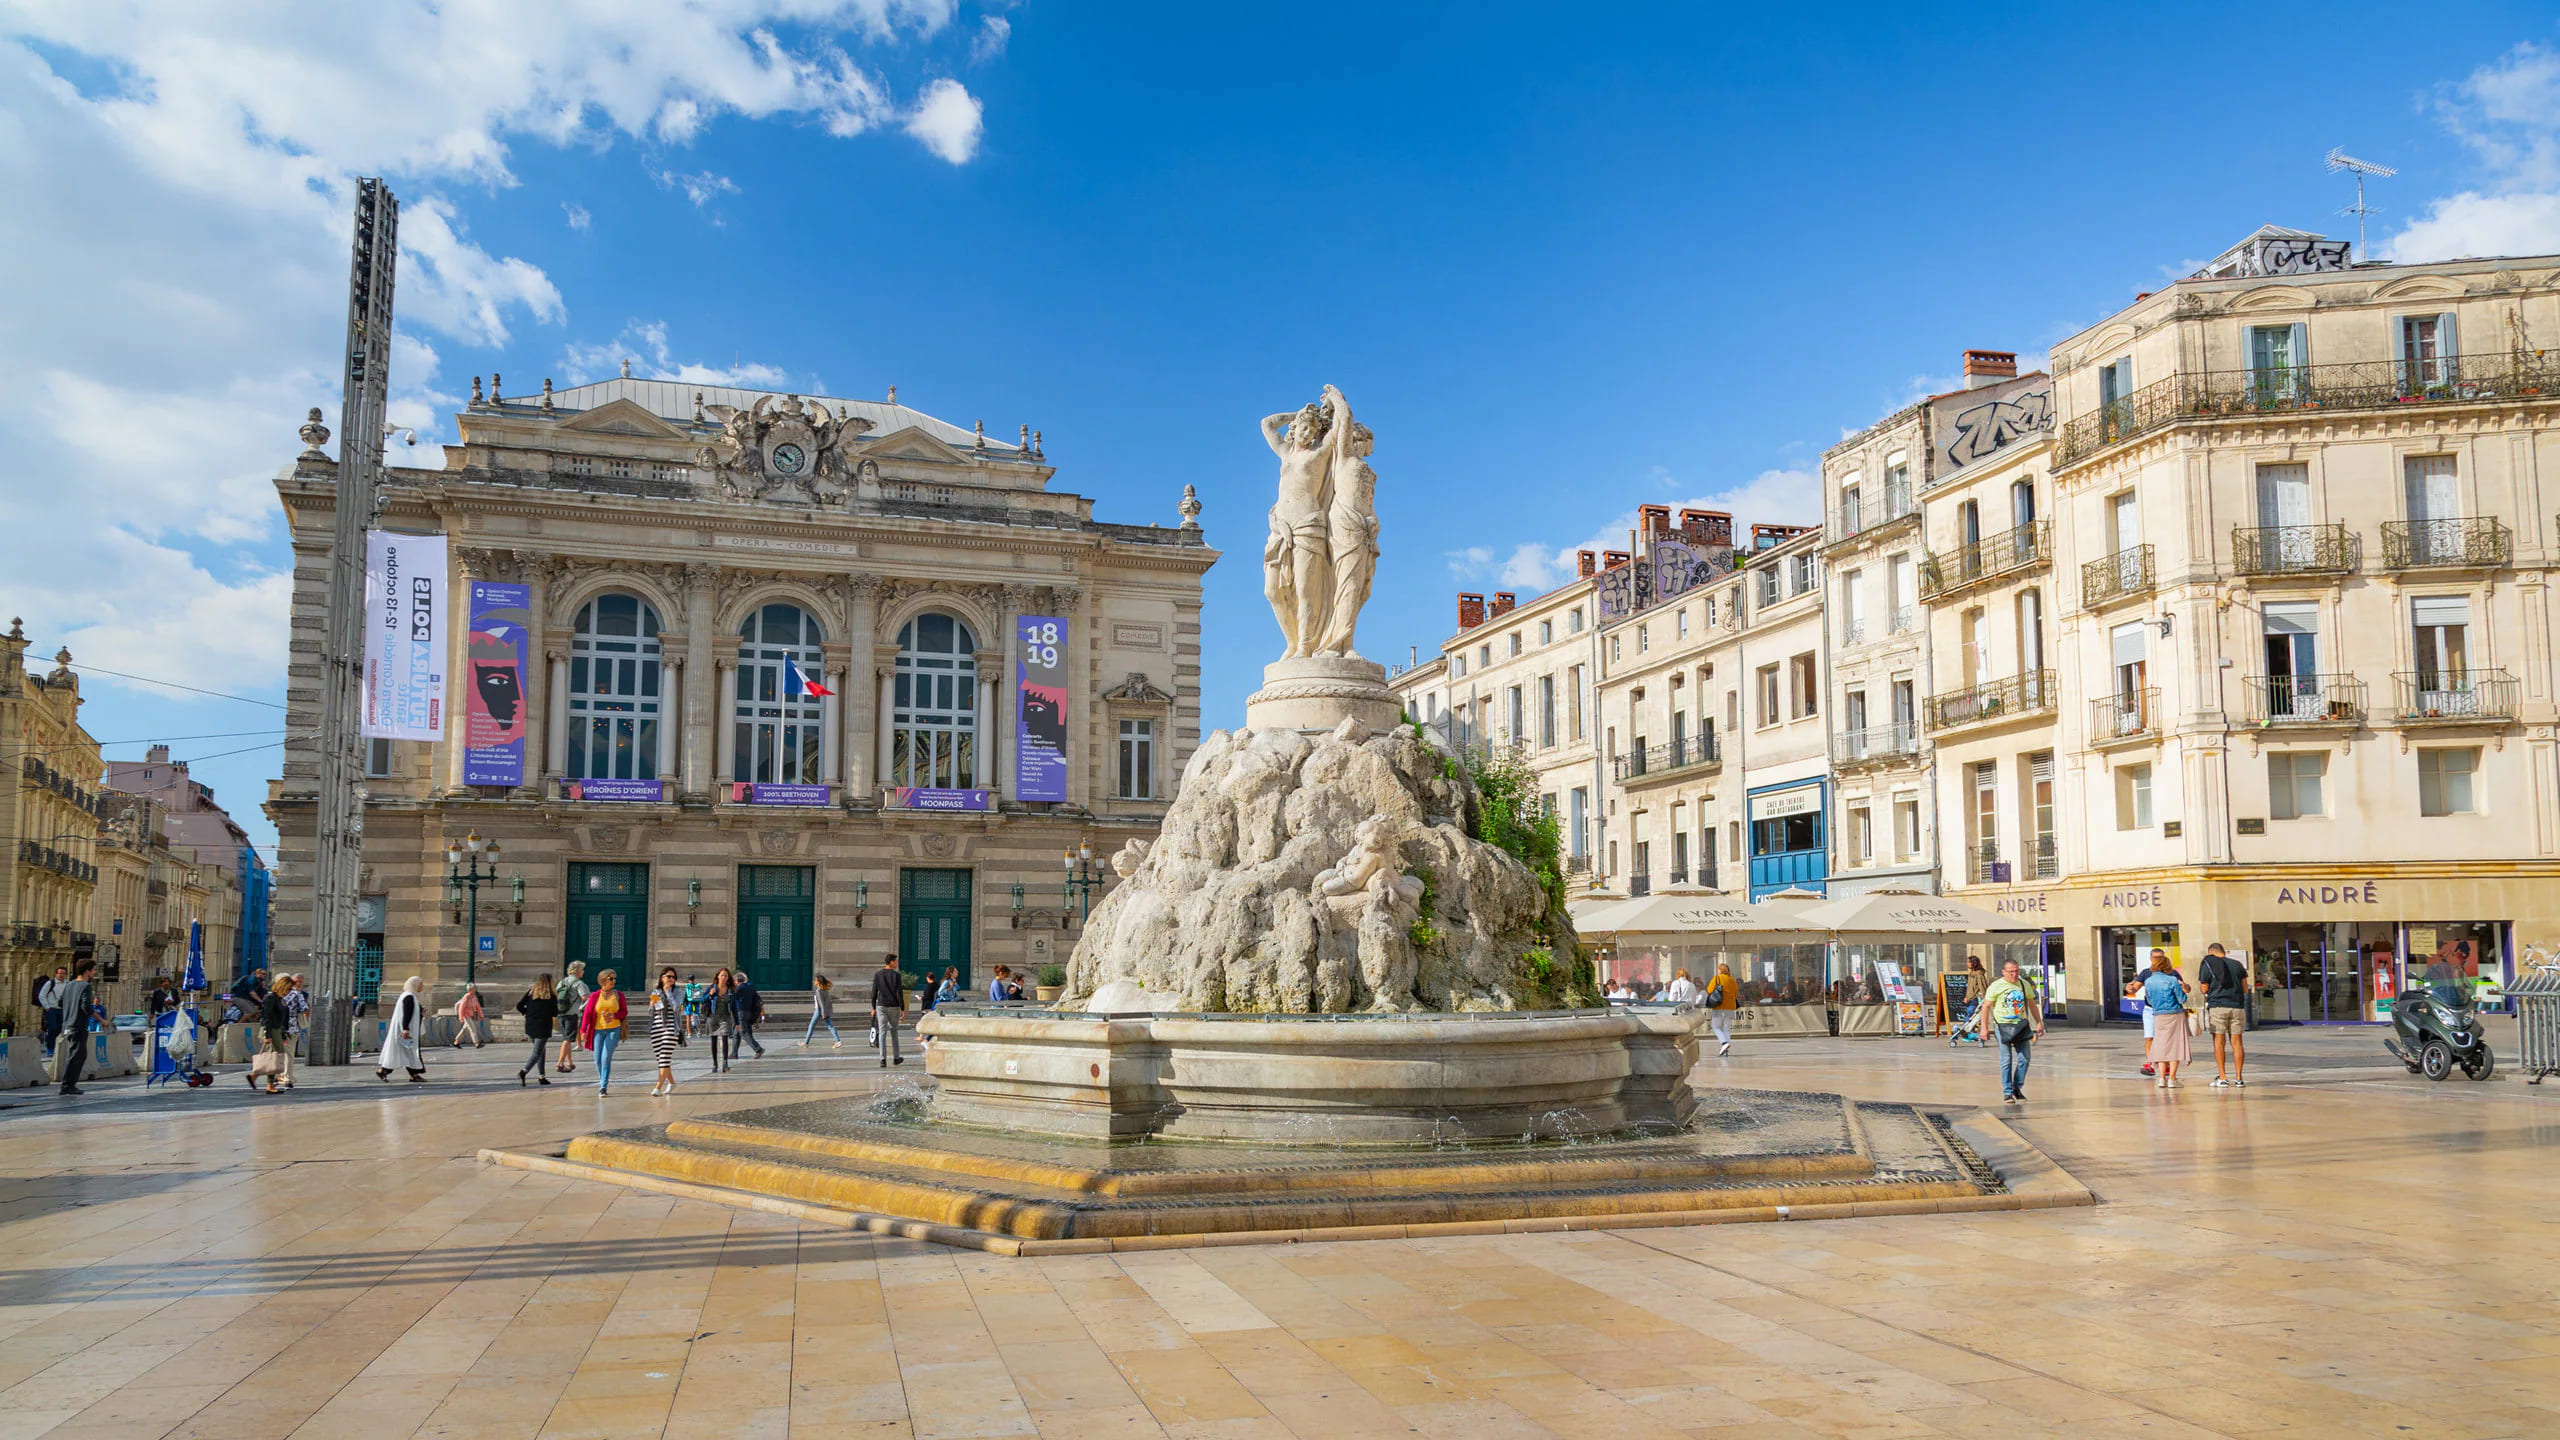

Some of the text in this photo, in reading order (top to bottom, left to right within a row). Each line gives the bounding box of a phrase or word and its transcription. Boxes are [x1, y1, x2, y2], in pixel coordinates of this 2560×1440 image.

[1028, 622, 1058, 645] 18
[1027, 645, 1058, 669] 19
[623, 786, 659, 795] D'ORIENT
[920, 800, 964, 808] MOONPASS
[2102, 886, 2161, 908] ANDRÉ
[2278, 880, 2379, 904] ANDRÉ
[1996, 893, 2047, 913] ANDRÉ
[1689, 909, 1748, 918] YAM'S
[1904, 909, 1961, 918] YAM'S
